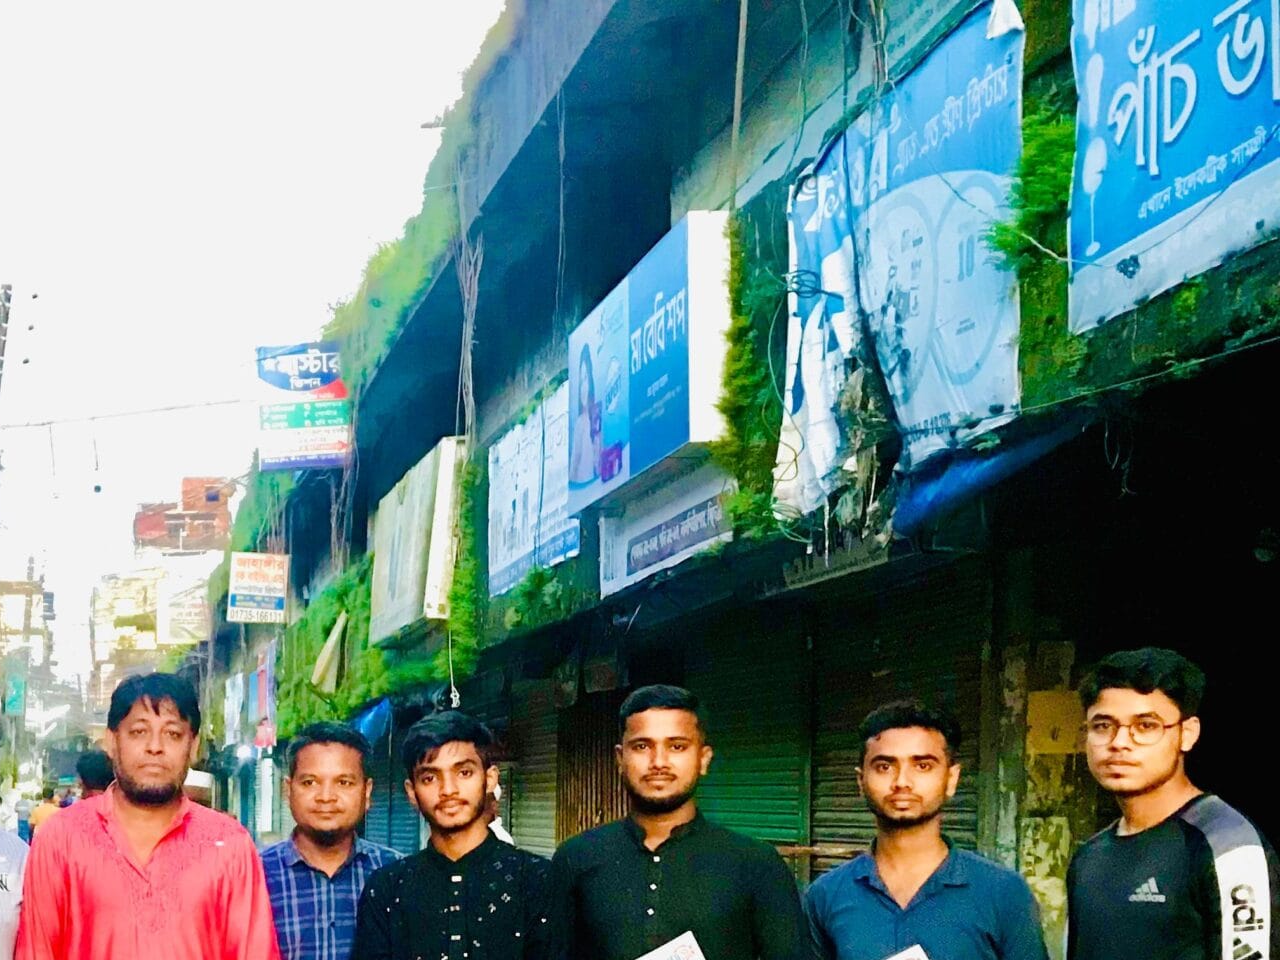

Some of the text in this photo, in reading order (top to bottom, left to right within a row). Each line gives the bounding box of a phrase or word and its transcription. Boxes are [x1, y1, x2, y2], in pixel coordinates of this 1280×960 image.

[1108, 25, 1201, 175] পাঁচ
[630, 328, 645, 374] মা
[1128, 892, 1167, 904] adidas
